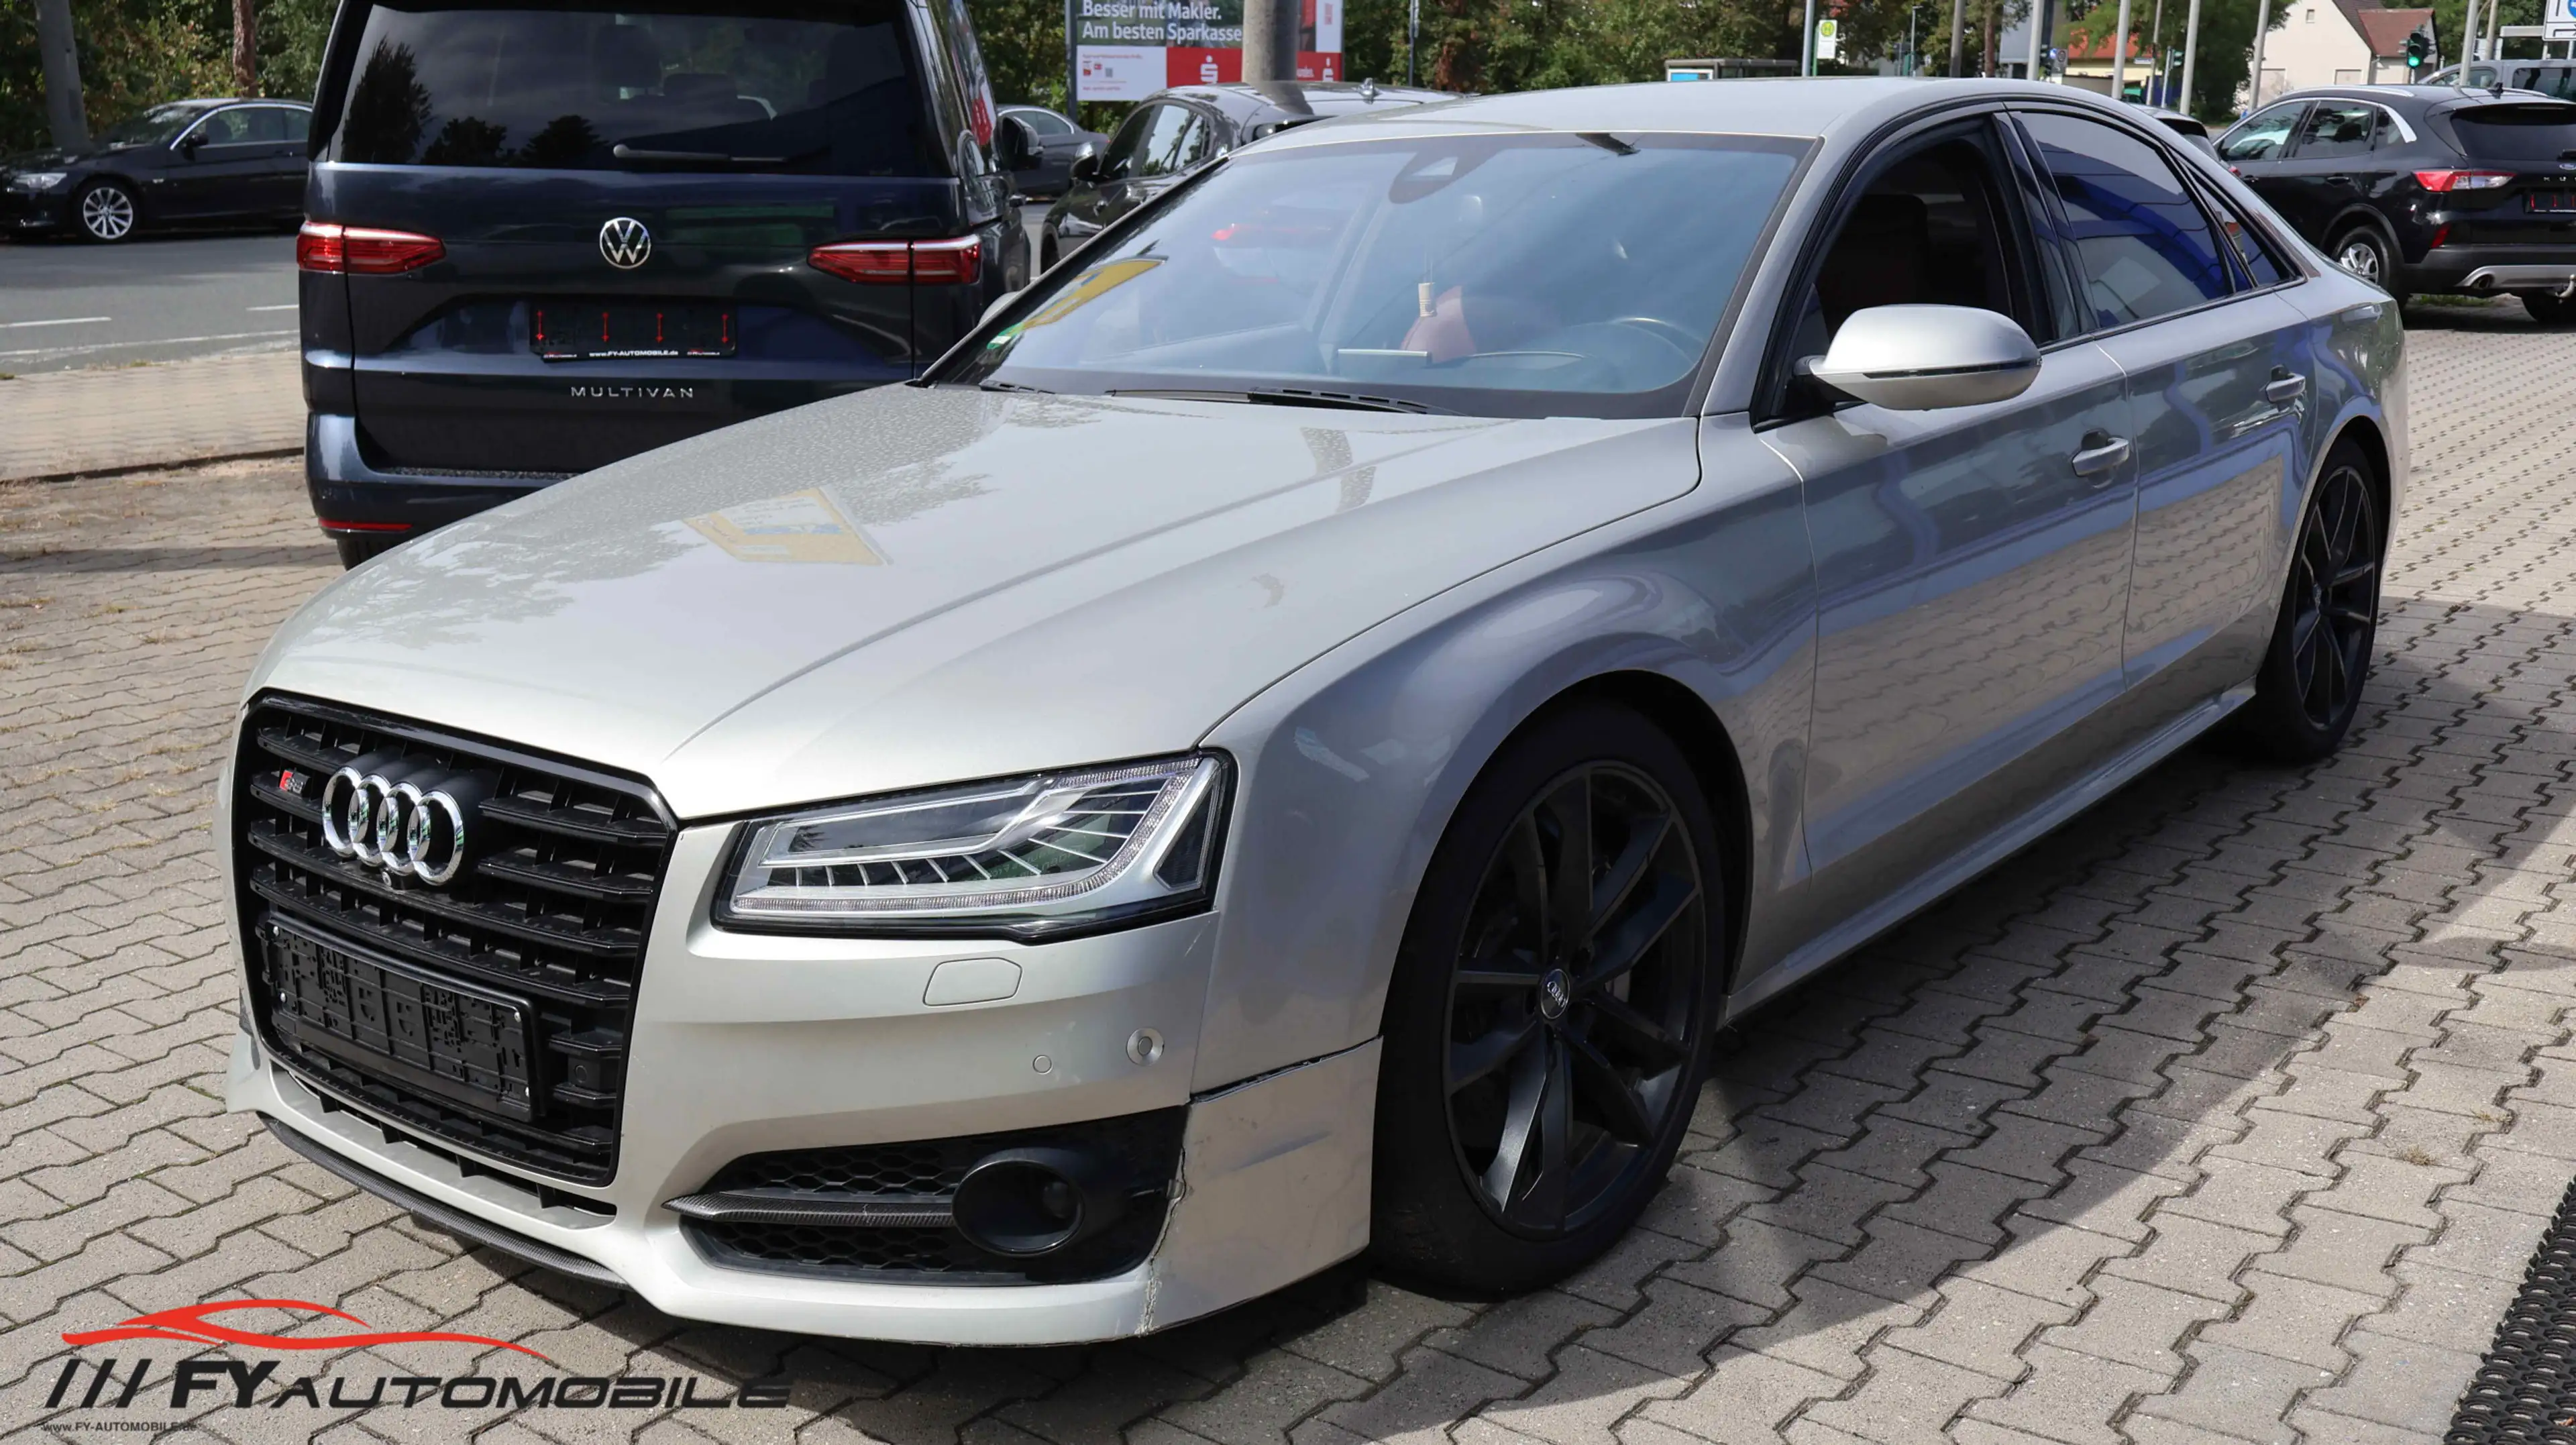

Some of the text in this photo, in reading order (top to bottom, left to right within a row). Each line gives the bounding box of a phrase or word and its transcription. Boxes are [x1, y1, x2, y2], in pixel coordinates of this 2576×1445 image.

[1083, 0, 1222, 19] Besser mit Makler.
[1082, 21, 1108, 38] Am
[1112, 21, 1164, 40] besten
[571, 386, 693, 398] MULTIVAN
